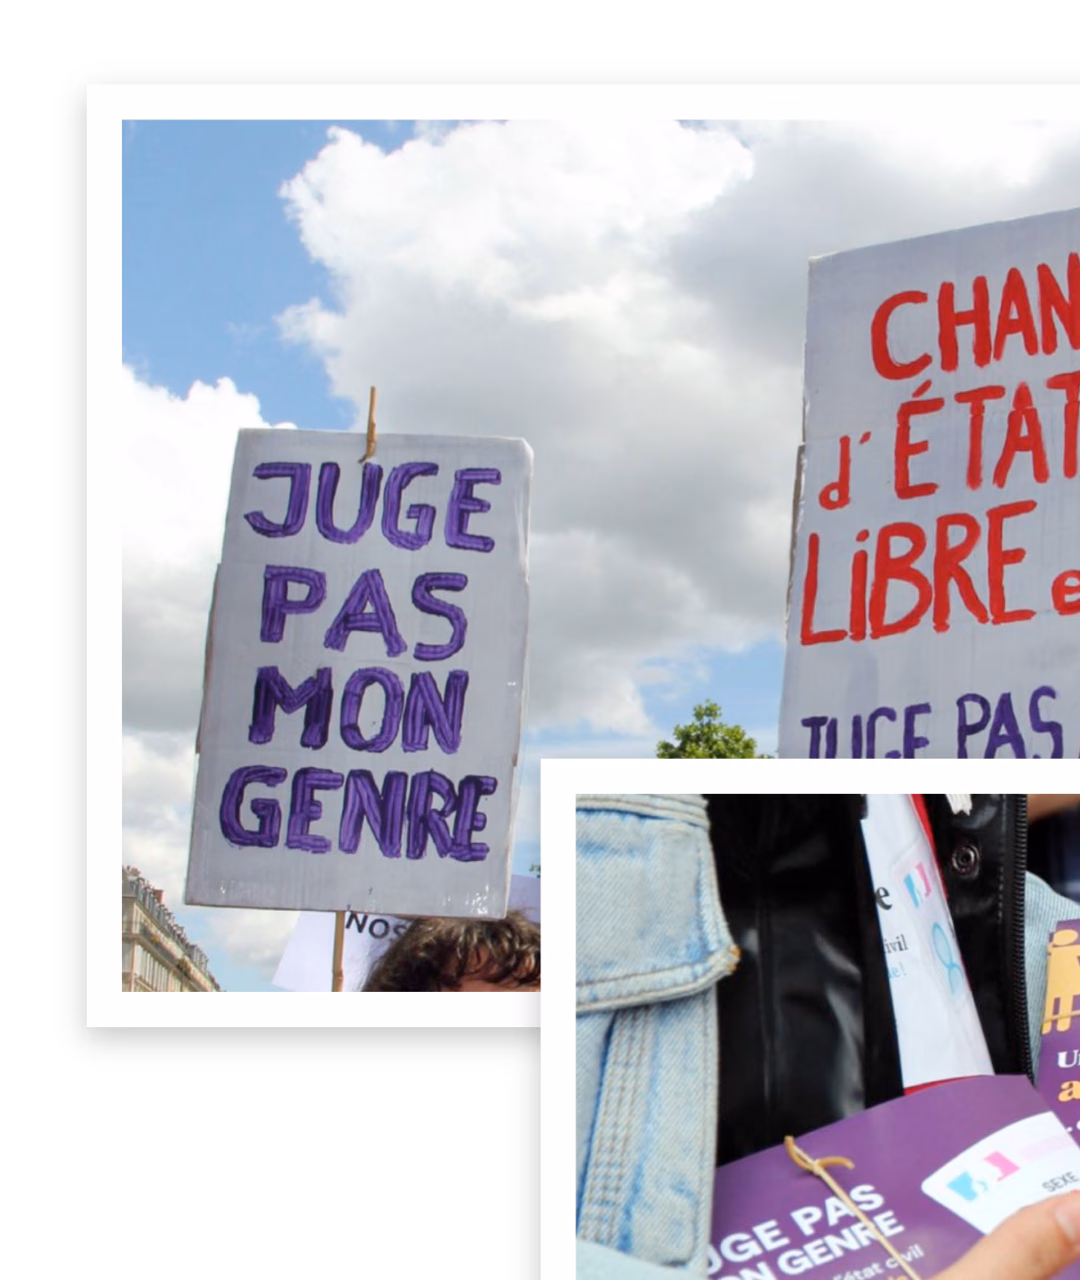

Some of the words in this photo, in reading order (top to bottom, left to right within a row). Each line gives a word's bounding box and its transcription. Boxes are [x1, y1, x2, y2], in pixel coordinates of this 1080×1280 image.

[244, 462, 502, 553] JUGE
[260, 565, 469, 661] PAS
[249, 667, 469, 755] MON
[957, 684, 1063, 758] PAS
[219, 765, 498, 862] GENRE
[777, 1210, 905, 1276] GENRE
[790, 1184, 885, 1236] PAS
